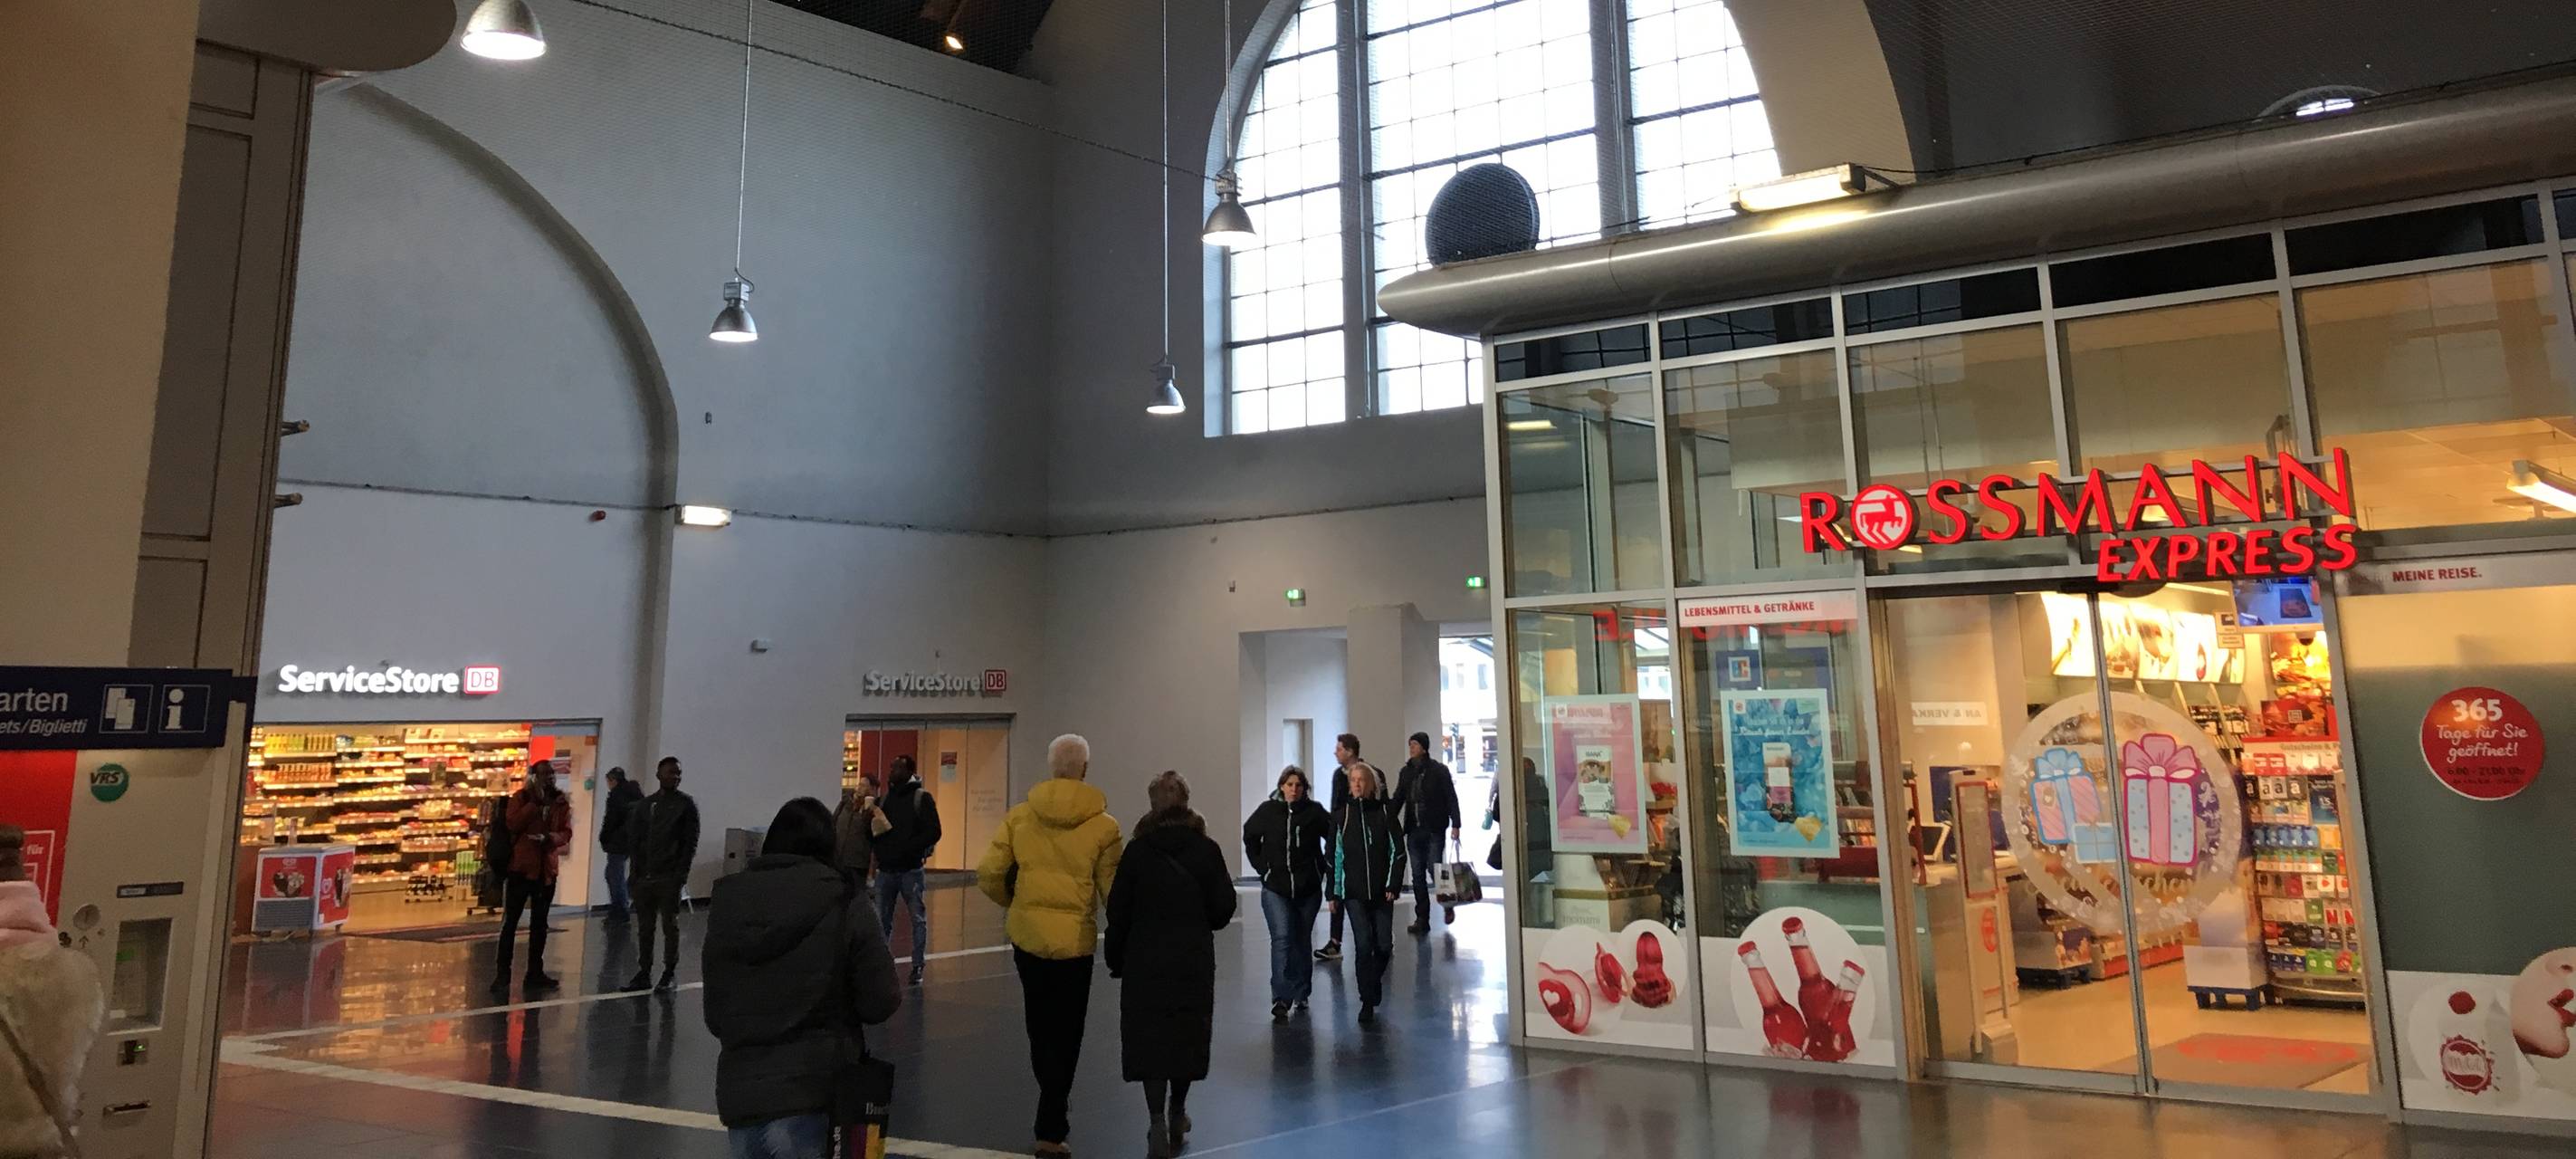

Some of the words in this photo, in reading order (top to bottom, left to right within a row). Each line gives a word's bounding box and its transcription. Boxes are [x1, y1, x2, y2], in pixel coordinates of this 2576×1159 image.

[1799, 447, 2355, 553] ROSSMANN
[2096, 523, 2359, 582] EXPRESS
[2392, 570, 2435, 582] MEINE
[2438, 567, 2483, 580] REISE.
[1684, 604, 1751, 618] LEBENSMITTEL
[1753, 604, 1761, 614] &
[1764, 600, 1815, 614] GETRÄNKE
[278, 665, 459, 694] ServiceStore
[467, 669, 497, 690] DB
[865, 670, 980, 692] ServiceStore
[986, 671, 1006, 690] DB
[0, 688, 69, 713] arten
[2451, 698, 2504, 723] 365
[2436, 724, 2472, 745] Tage
[2475, 724, 2499, 739] für
[2503, 723, 2529, 738] Sie
[2446, 742, 2518, 763] geöffnet!
[91, 771, 120, 784] VRS
